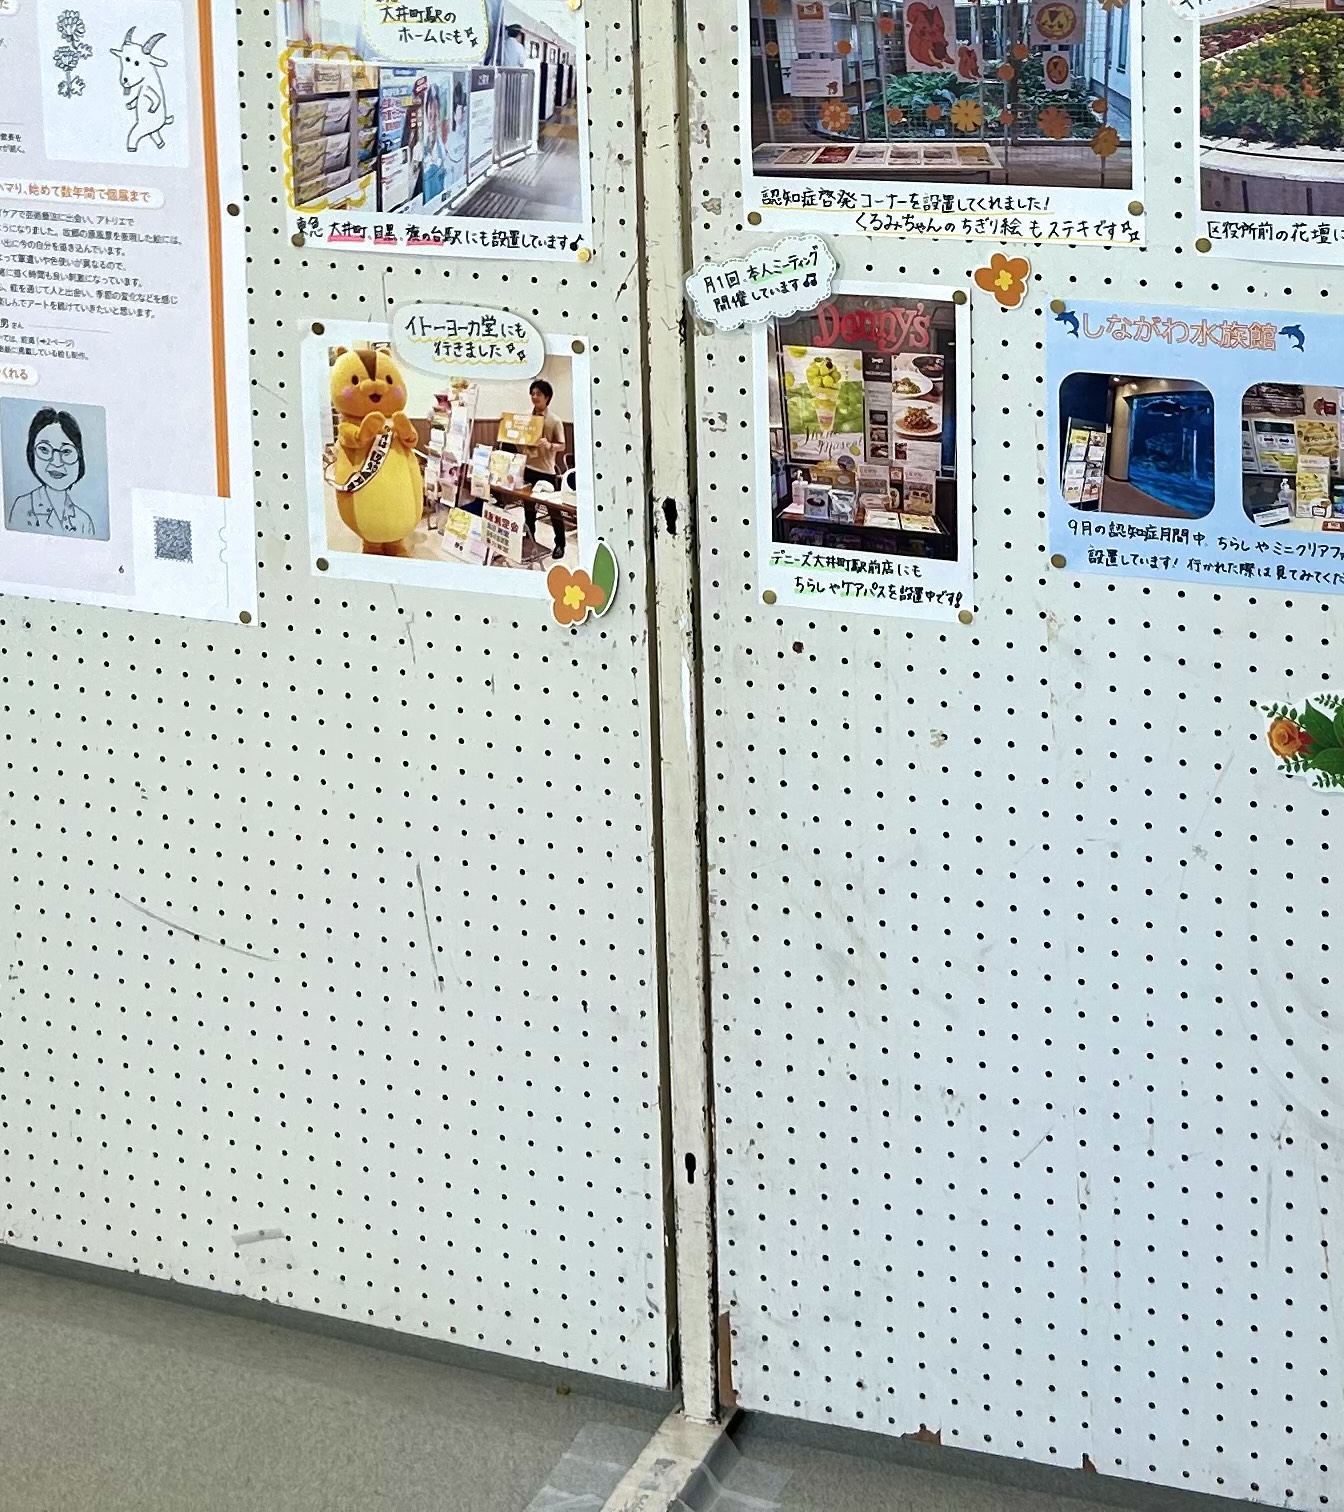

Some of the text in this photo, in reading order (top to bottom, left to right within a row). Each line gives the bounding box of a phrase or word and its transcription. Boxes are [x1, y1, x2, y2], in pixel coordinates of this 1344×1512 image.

[381, 6, 457, 23] 大井町駅の
[398, 26, 464, 44] ホームにも
[296, 216, 324, 238] 東急
[713, 280, 800, 313] 開催しています
[405, 315, 526, 339] イトーヨーカ堂にも
[813, 301, 933, 354] Denny's
[1082, 311, 1279, 353] しながわ水族館
[433, 341, 503, 359] 行きました
[769, 551, 923, 578] デニーズ大井町駅前店にも
